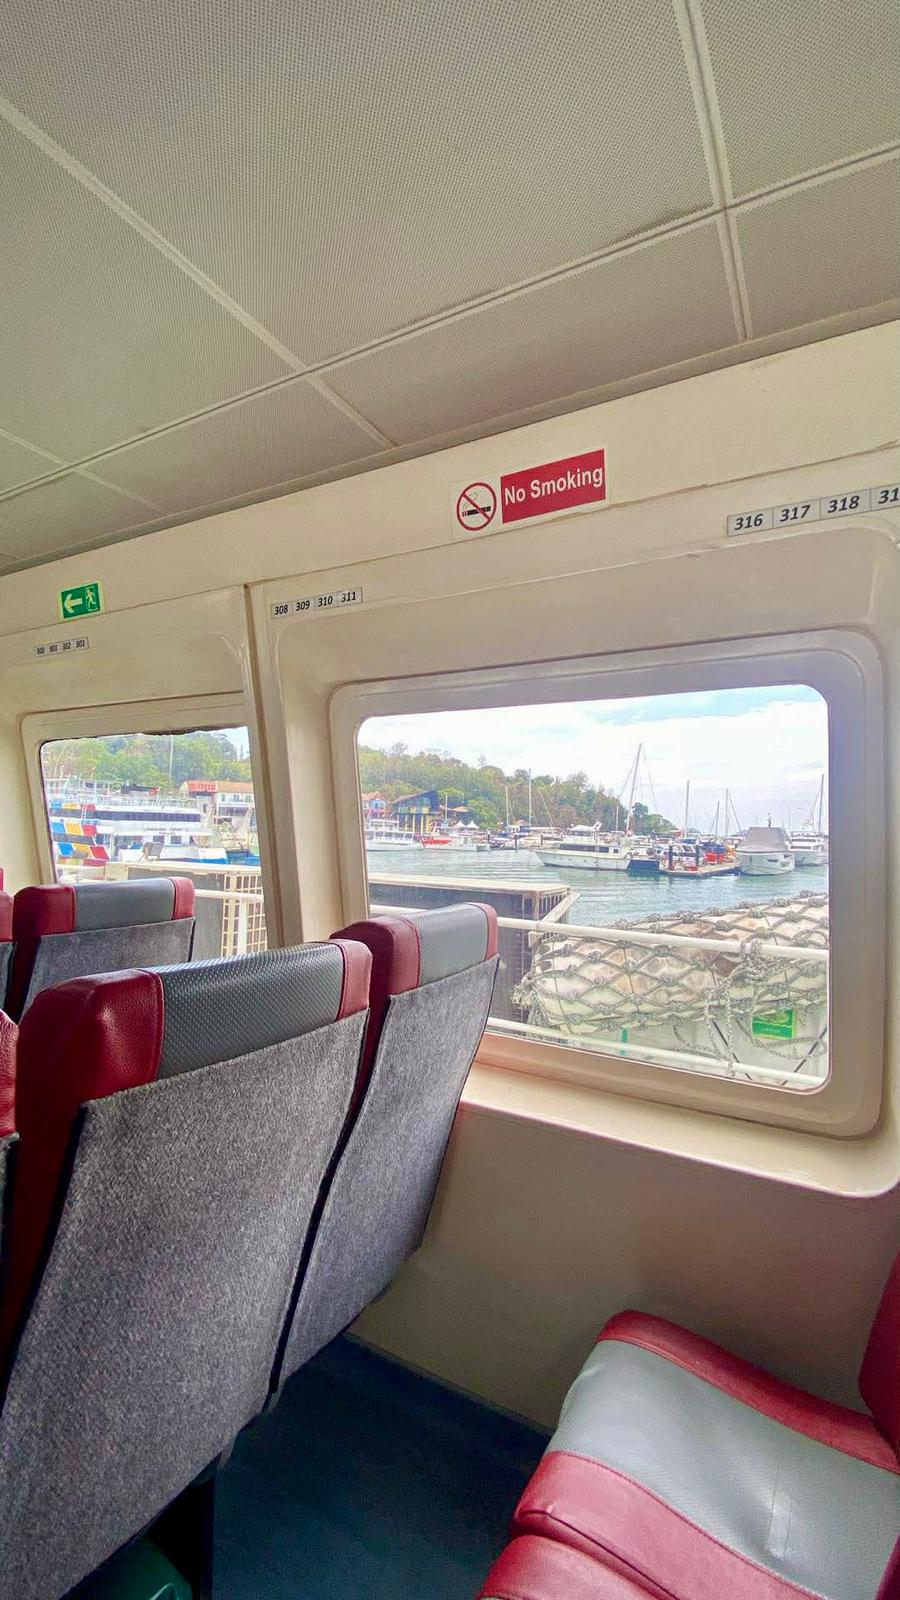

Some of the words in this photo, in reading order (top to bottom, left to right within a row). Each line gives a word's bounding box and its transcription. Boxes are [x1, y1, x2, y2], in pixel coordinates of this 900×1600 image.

[504, 486, 526, 506] No
[530, 467, 603, 498] Smoking
[734, 513, 763, 531] 316
[779, 504, 811, 522] 317
[827, 495, 860, 514] 318
[274, 604, 289, 615] 308
[295, 600, 311, 611] 309
[318, 595, 333, 607] 310
[341, 591, 356, 602] 311
